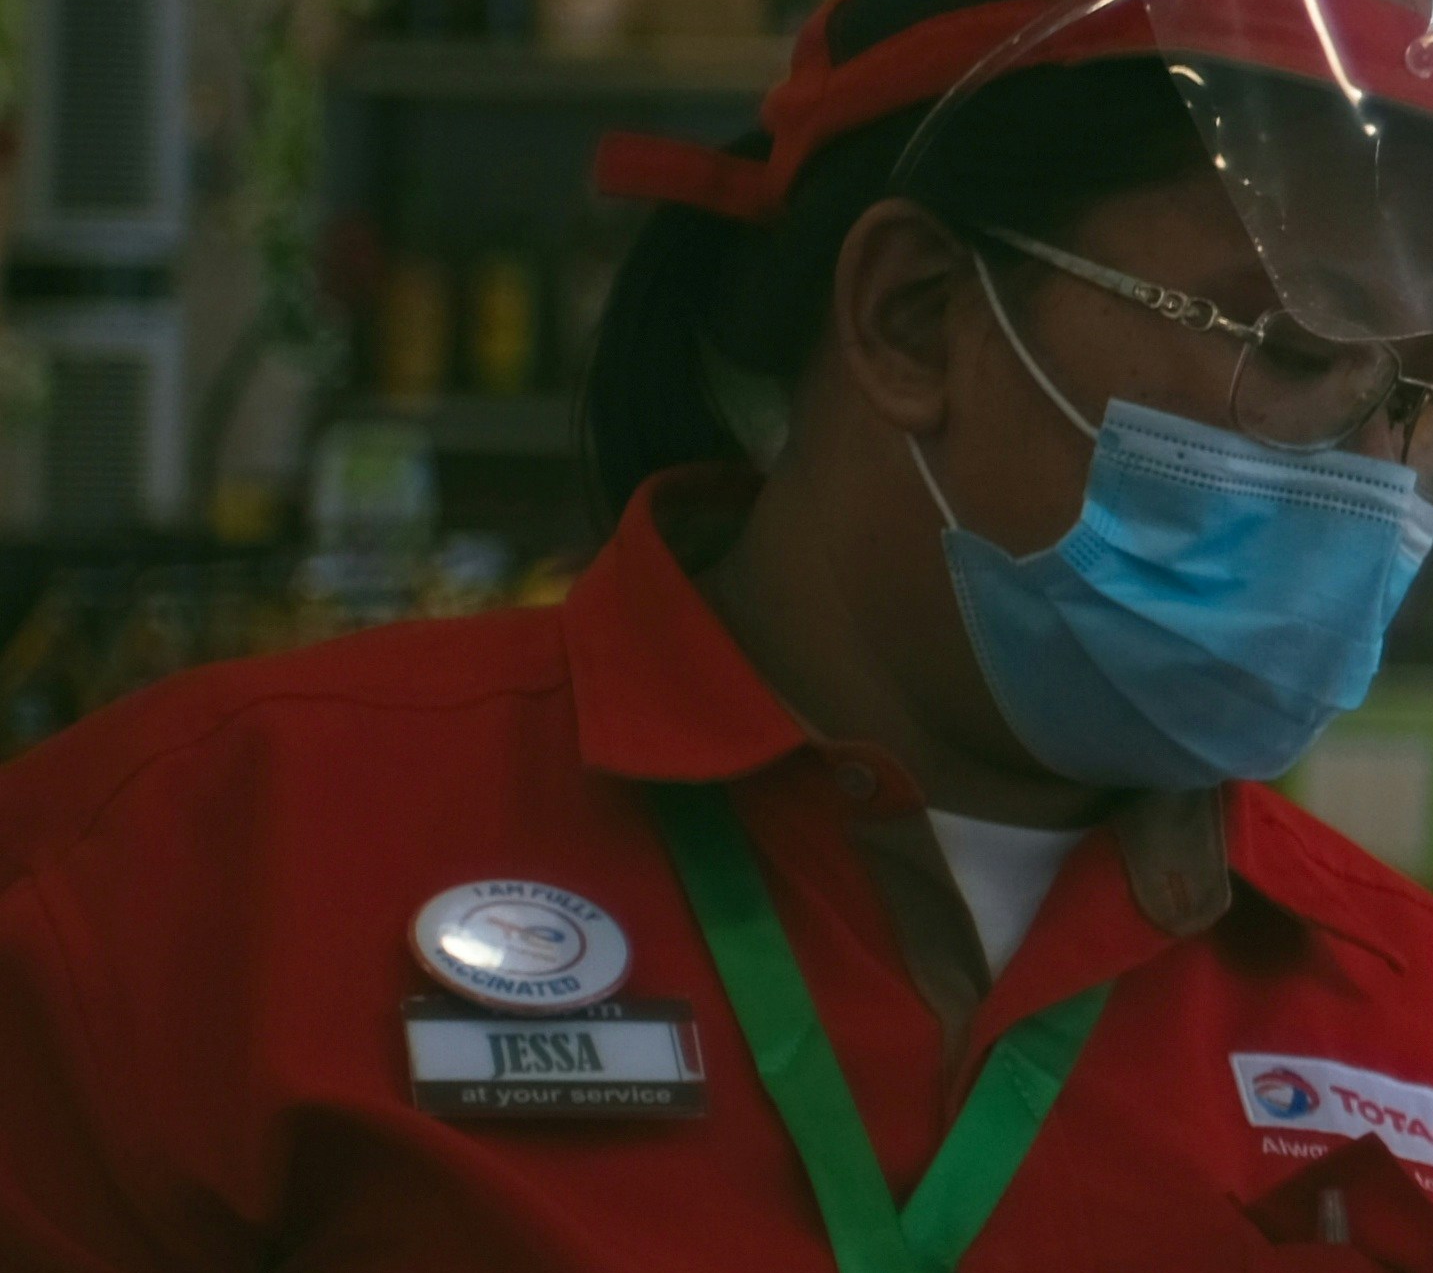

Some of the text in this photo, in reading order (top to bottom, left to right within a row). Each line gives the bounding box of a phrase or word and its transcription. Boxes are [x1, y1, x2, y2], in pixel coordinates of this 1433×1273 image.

[489, 883, 523, 896] AM
[530, 883, 600, 921] FULLY
[486, 1031, 603, 1076] JESSA
[461, 1086, 671, 1107] at your service
